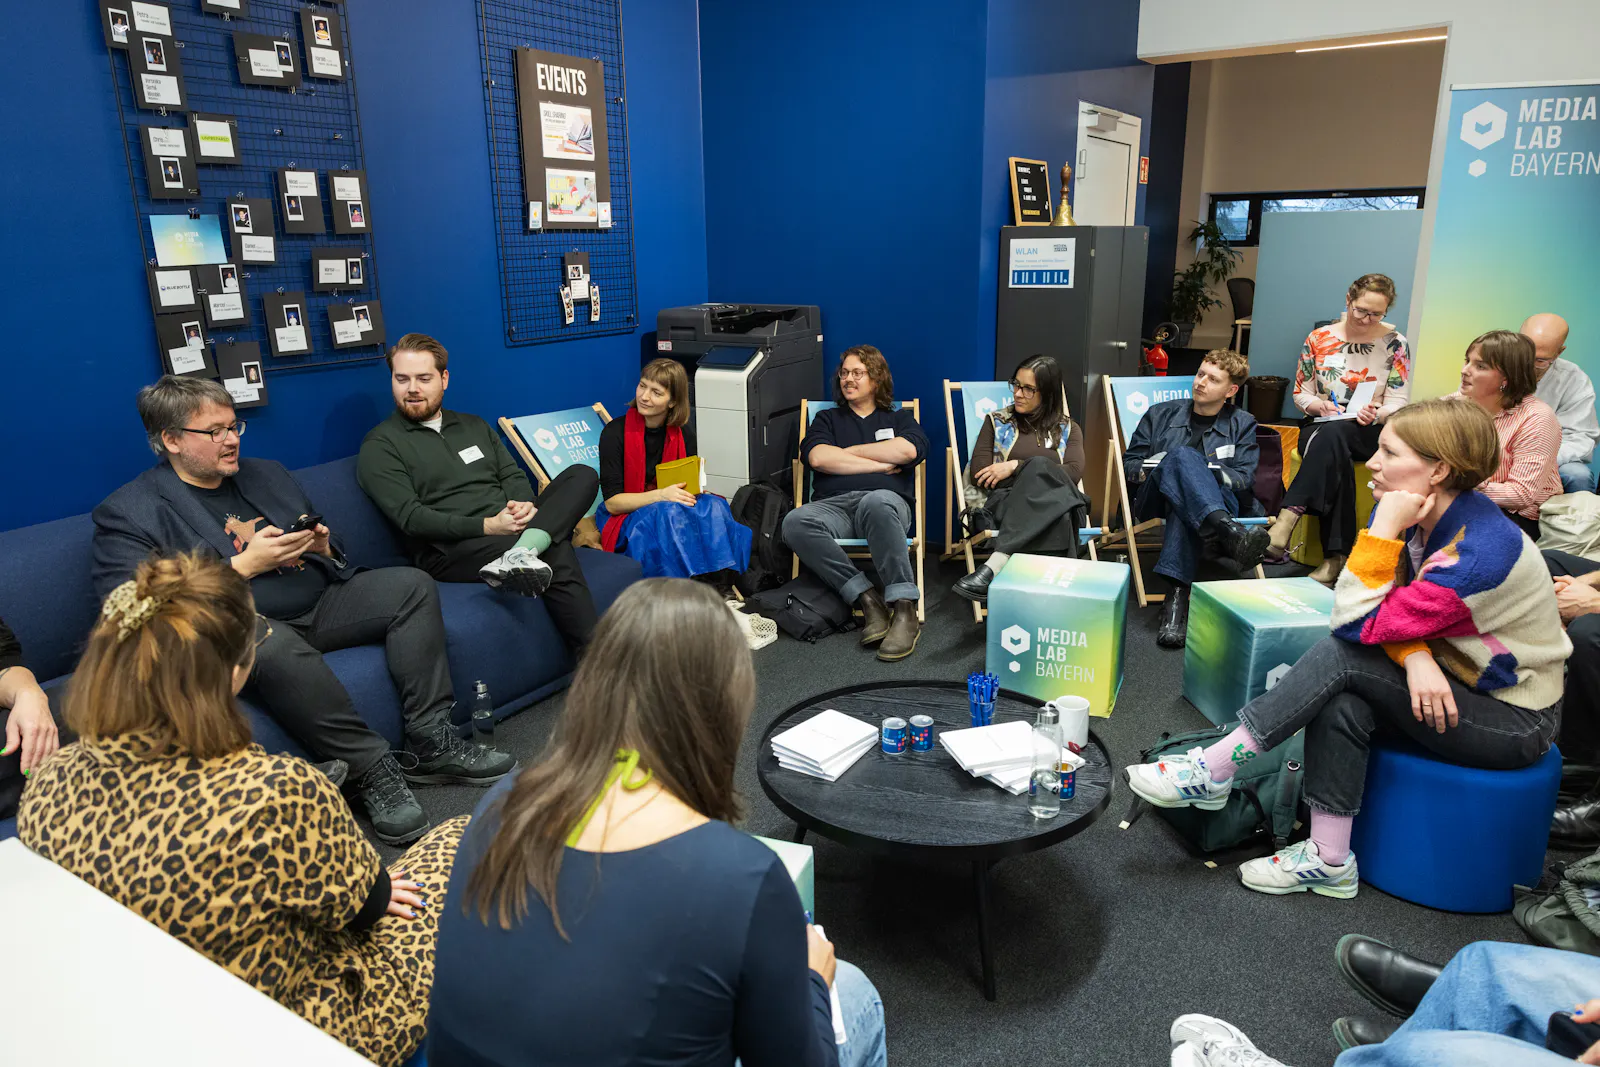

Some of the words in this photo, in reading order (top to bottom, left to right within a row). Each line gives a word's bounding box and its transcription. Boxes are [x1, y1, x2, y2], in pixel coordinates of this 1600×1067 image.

[536, 62, 588, 96] EVENTS
[1518, 96, 1597, 123] MEDIA
[1514, 125, 1562, 150] LAB
[1510, 151, 1600, 177] BAYERN
[1153, 389, 1191, 403] MEDIA
[555, 420, 591, 436] MEDIA
[561, 435, 585, 449] LAB
[568, 444, 600, 463] BAYER
[1037, 626, 1089, 648] MEDIA
[1036, 643, 1068, 662] LAB
[1035, 660, 1096, 684] BAYERN
